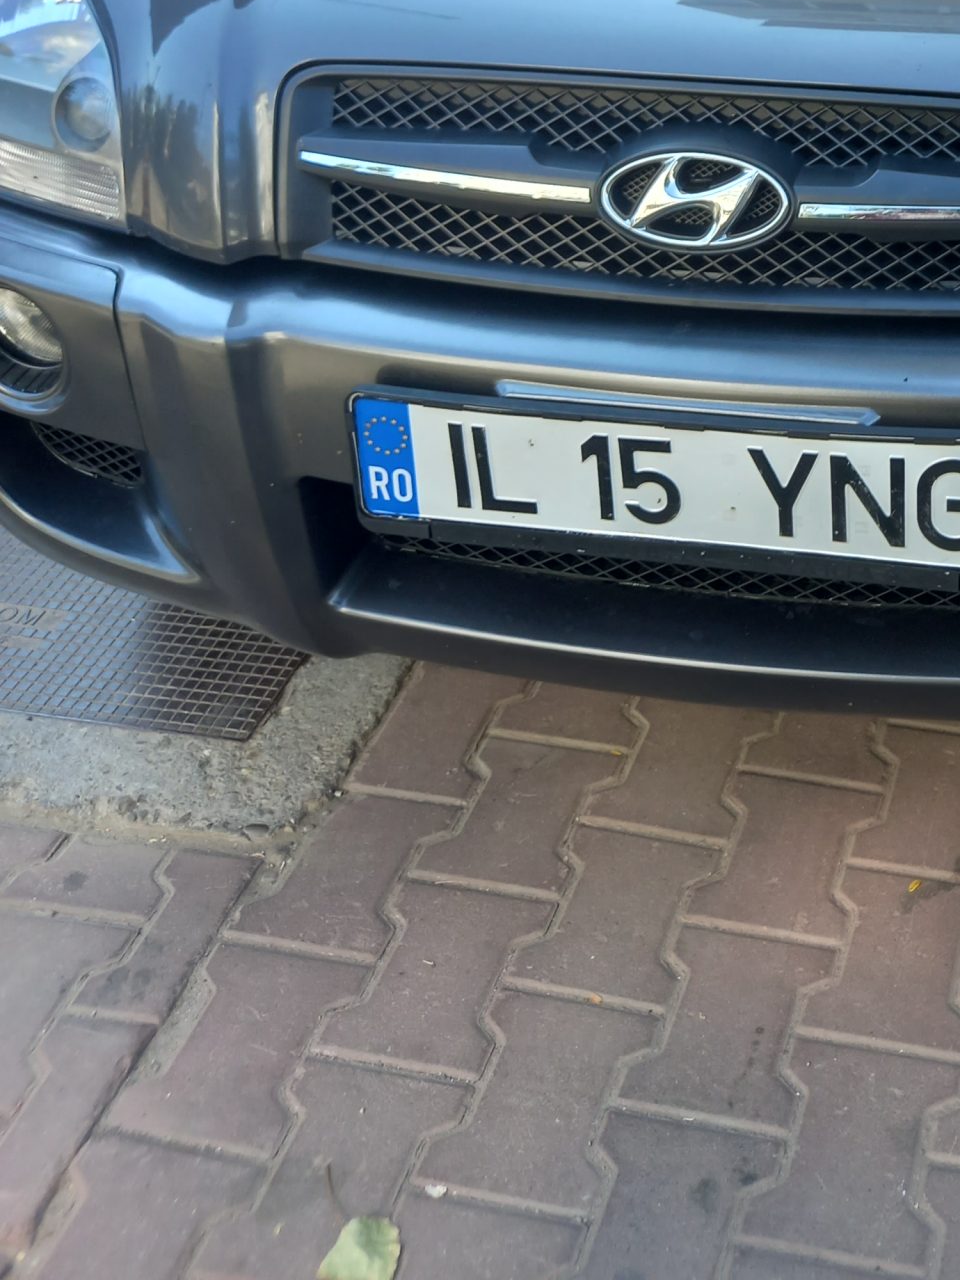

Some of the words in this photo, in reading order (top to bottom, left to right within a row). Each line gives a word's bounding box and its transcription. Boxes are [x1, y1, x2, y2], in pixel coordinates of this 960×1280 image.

[368, 465, 414, 503] RO
[447, 422, 539, 515] IL
[580, 433, 682, 524] 15
